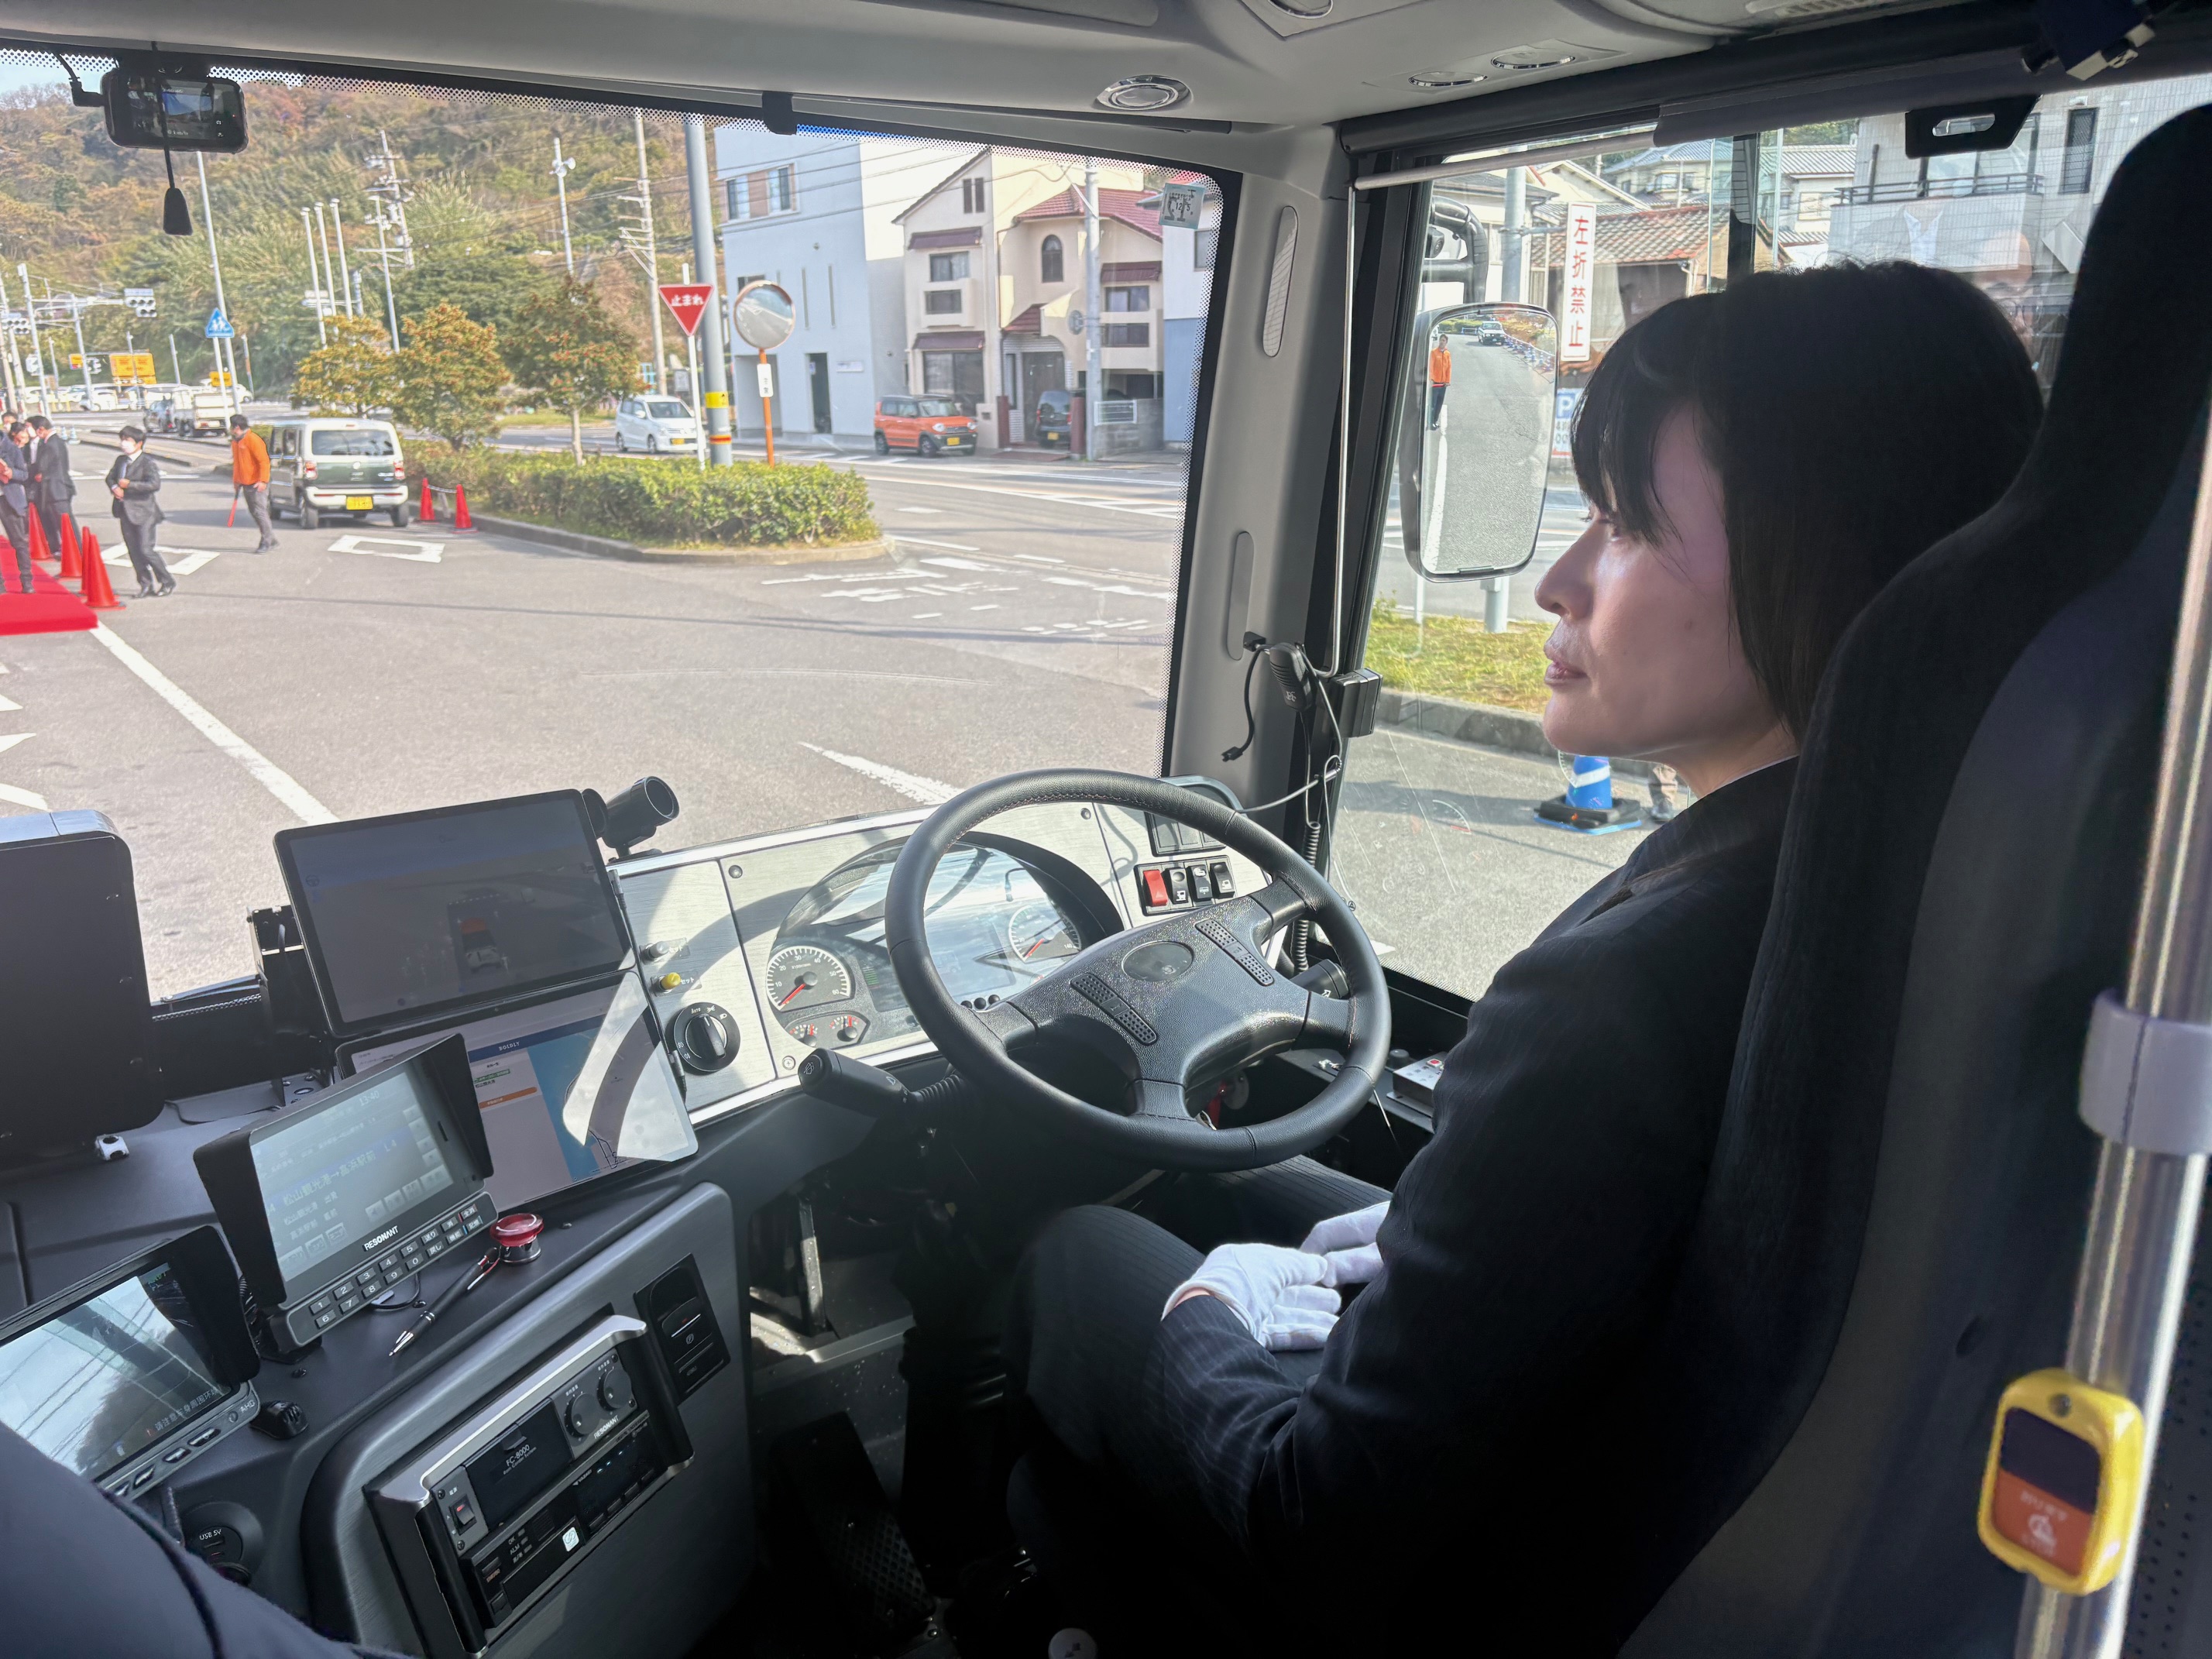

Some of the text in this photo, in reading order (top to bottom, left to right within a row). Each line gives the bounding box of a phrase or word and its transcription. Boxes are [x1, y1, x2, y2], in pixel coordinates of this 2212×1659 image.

[1569, 215, 1589, 347] 左折禁止
[671, 294, 704, 307] 止まれ
[498, 1041, 520, 1051] BOLDLY
[359, 1091, 380, 1107] 13:40
[364, 1225, 399, 1251] RESONANT
[239, 1399, 256, 1413] AHD
[593, 1414, 619, 1439] RESONANT
[506, 1444, 530, 1467] FC-8000
[199, 1531, 212, 1540] USB
